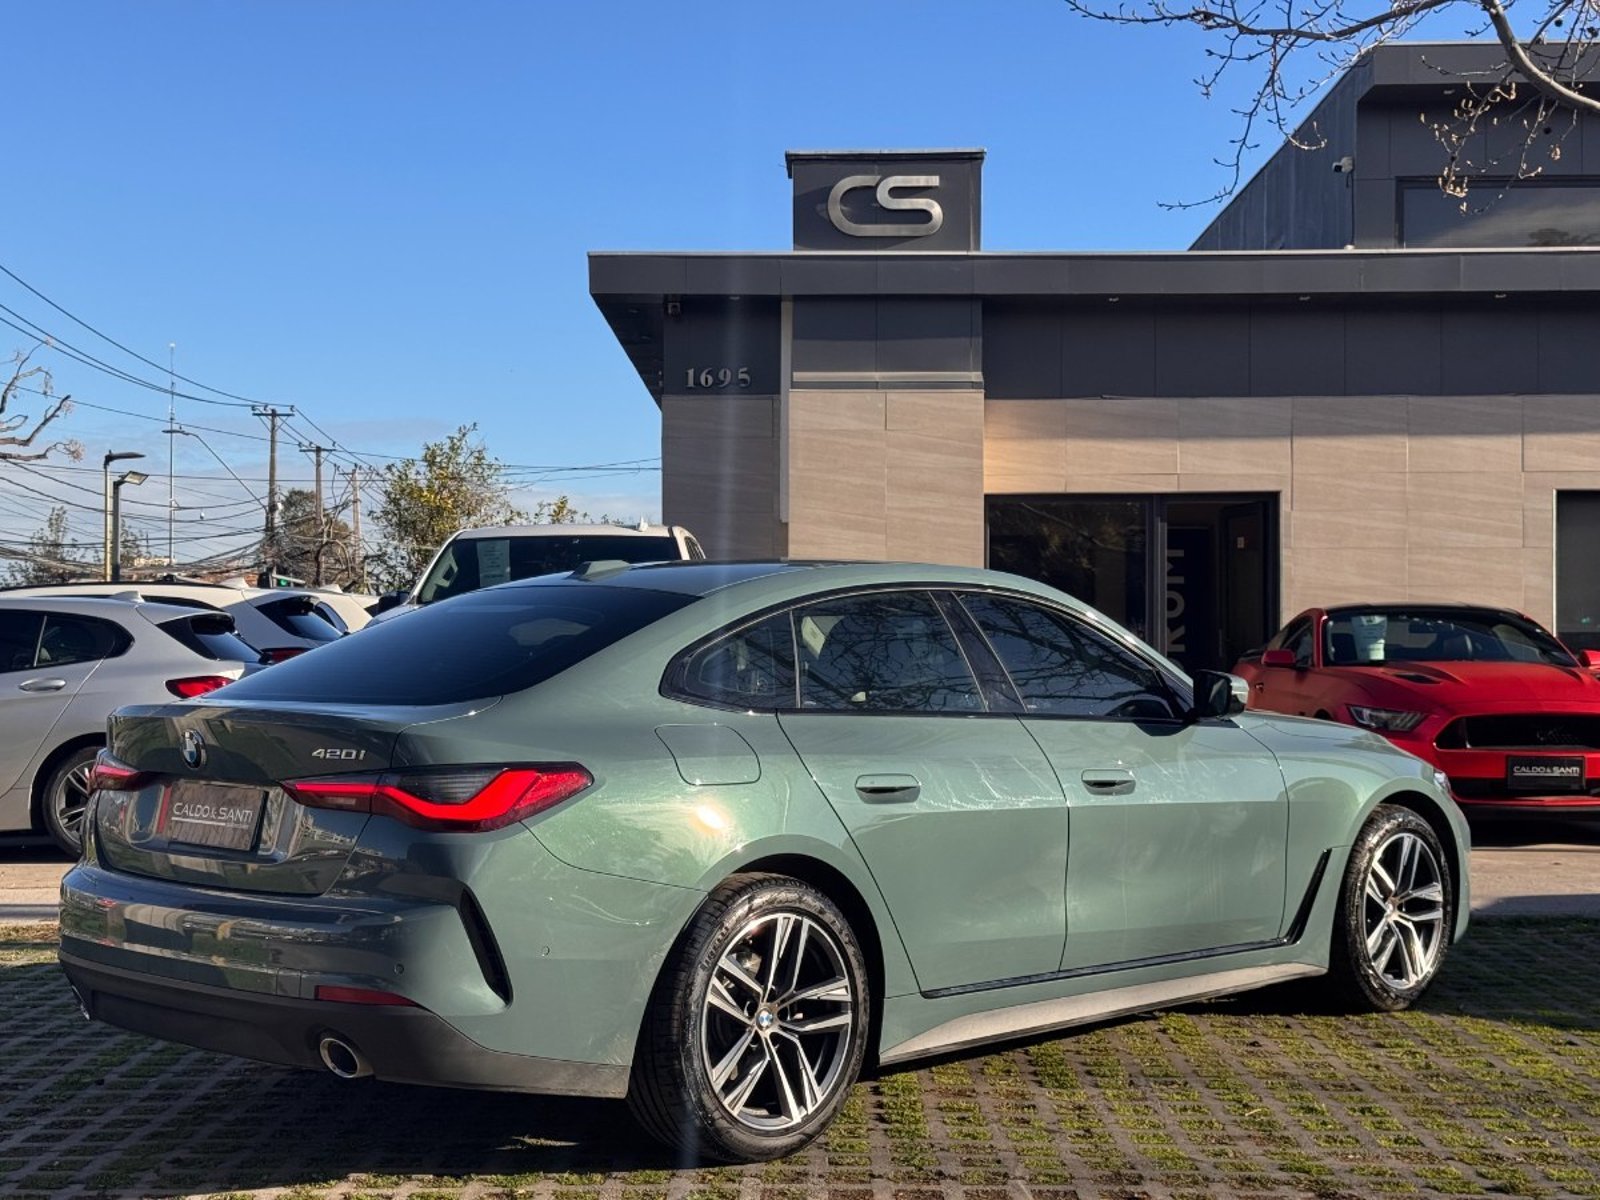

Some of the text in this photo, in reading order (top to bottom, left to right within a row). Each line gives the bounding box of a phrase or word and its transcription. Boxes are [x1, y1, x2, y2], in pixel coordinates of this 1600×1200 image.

[827, 174, 944, 237] CS
[686, 367, 751, 388] 1695
[311, 748, 366, 760] 420i
